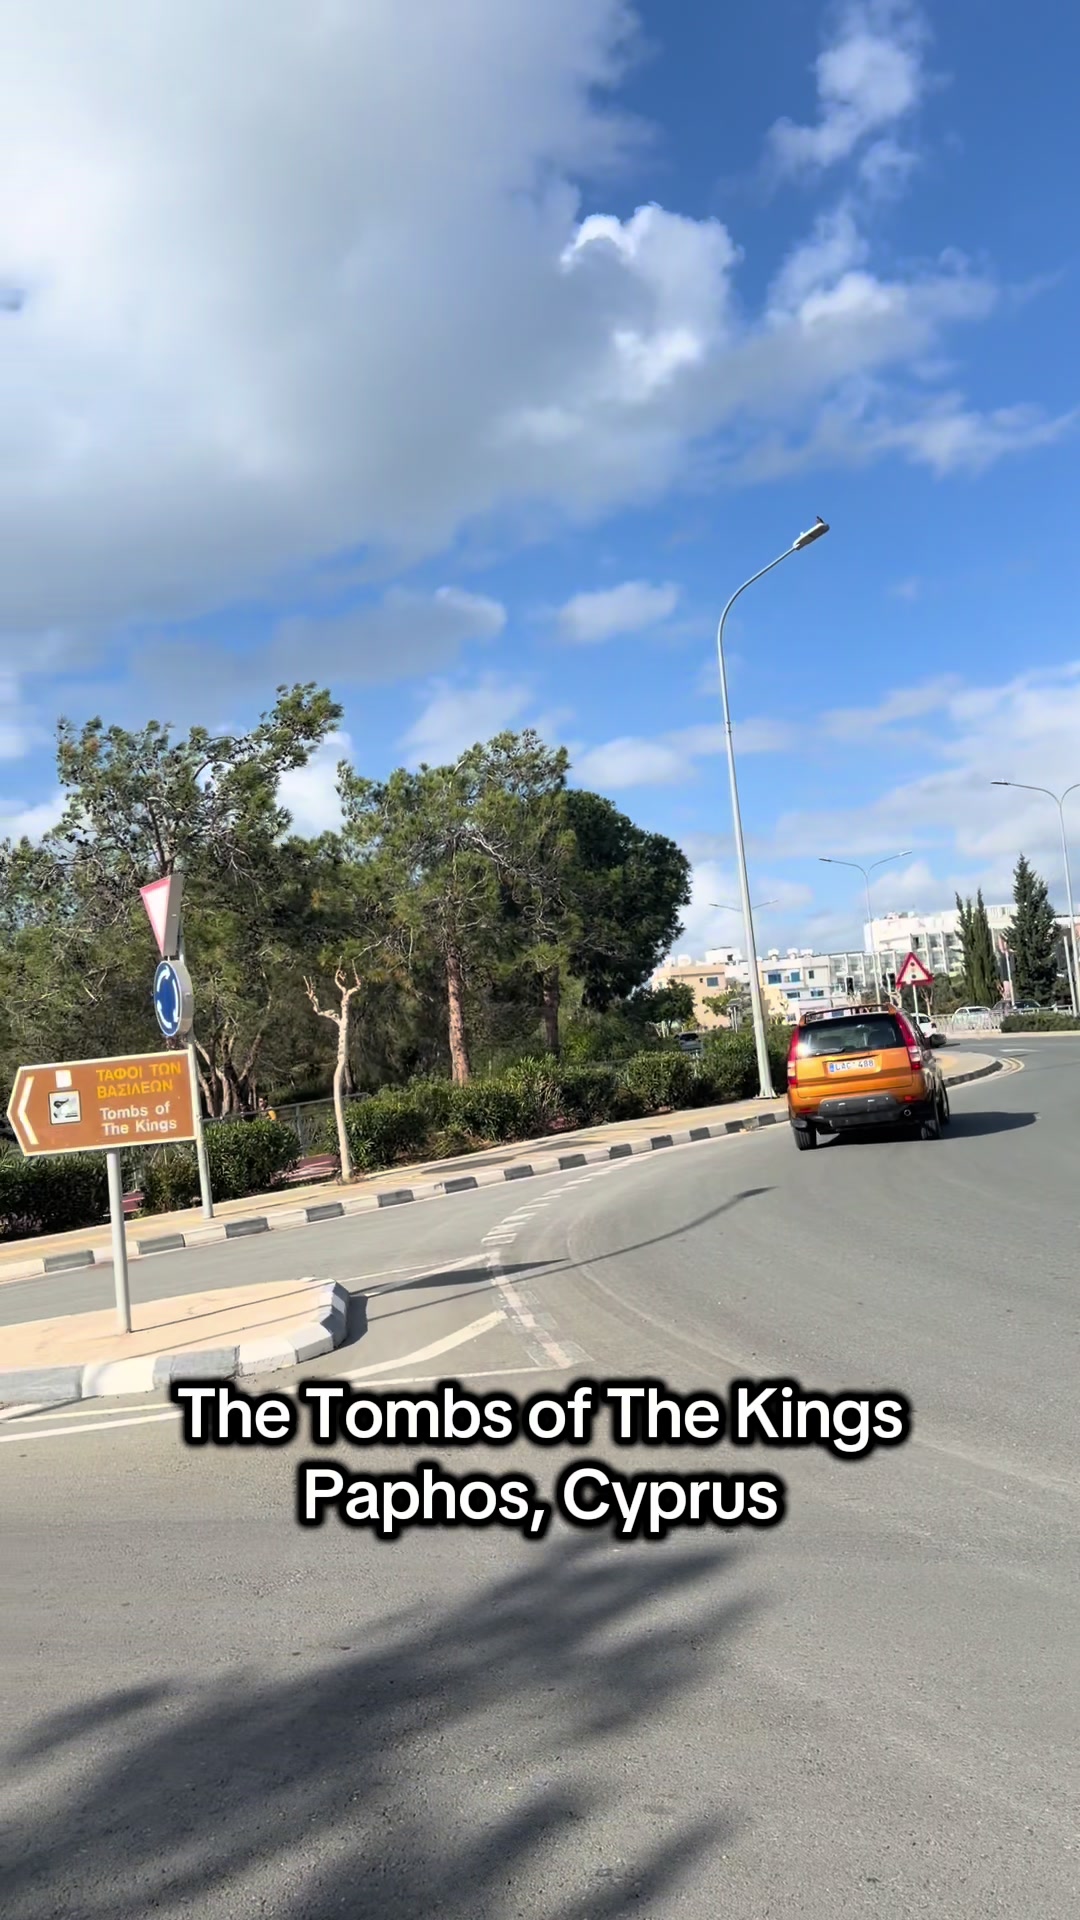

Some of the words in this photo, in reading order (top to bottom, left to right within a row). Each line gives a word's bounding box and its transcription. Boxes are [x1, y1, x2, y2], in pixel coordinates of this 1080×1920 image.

[96, 1066, 143, 1081] ΤΑΦΟΙ
[149, 1061, 181, 1076] ΤΩΝ
[97, 1080, 173, 1099] ΒΑΣΙΛΕΩΝ
[99, 1105, 148, 1120] Tombs
[155, 1101, 170, 1115] of
[101, 1122, 129, 1136] The
[135, 1119, 177, 1133] Kings
